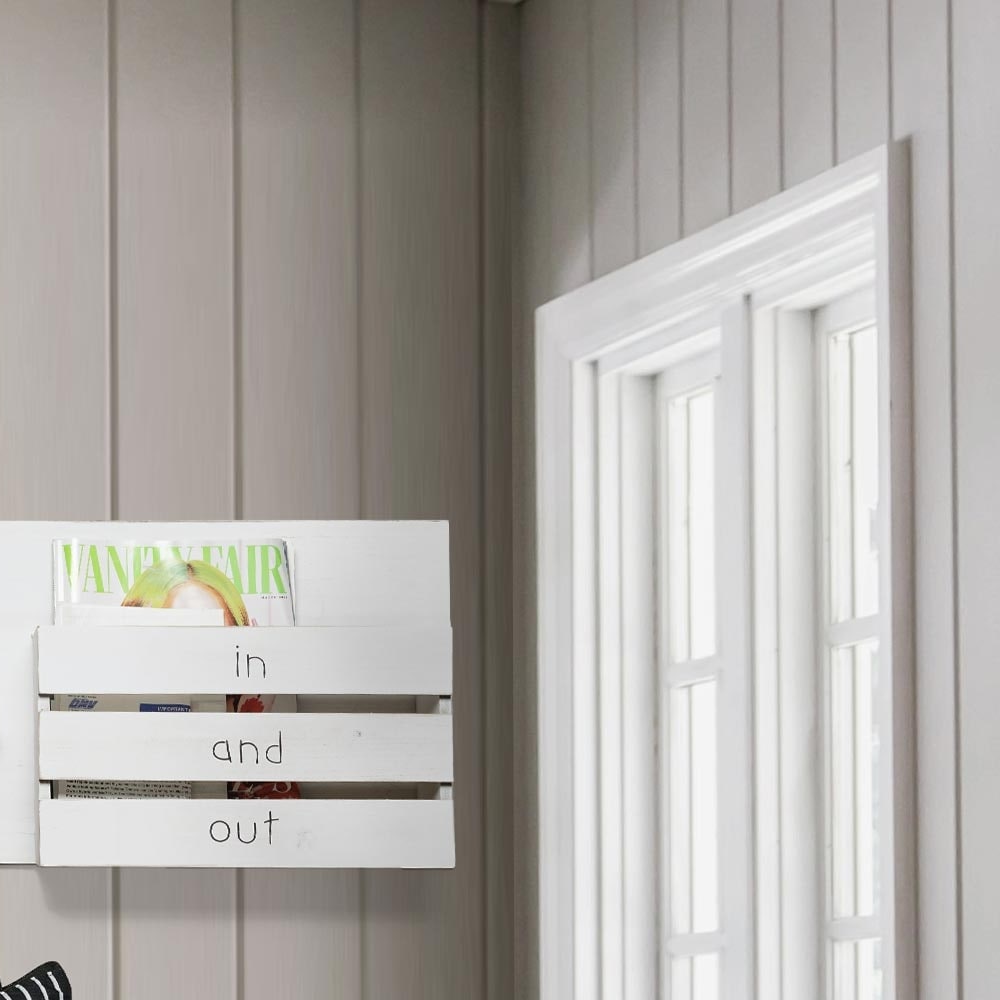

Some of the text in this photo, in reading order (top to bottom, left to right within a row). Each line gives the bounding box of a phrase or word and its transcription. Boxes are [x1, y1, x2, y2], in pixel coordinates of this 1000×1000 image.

[235, 645, 266, 678] in
[212, 731, 283, 764] and
[209, 811, 279, 844] out
